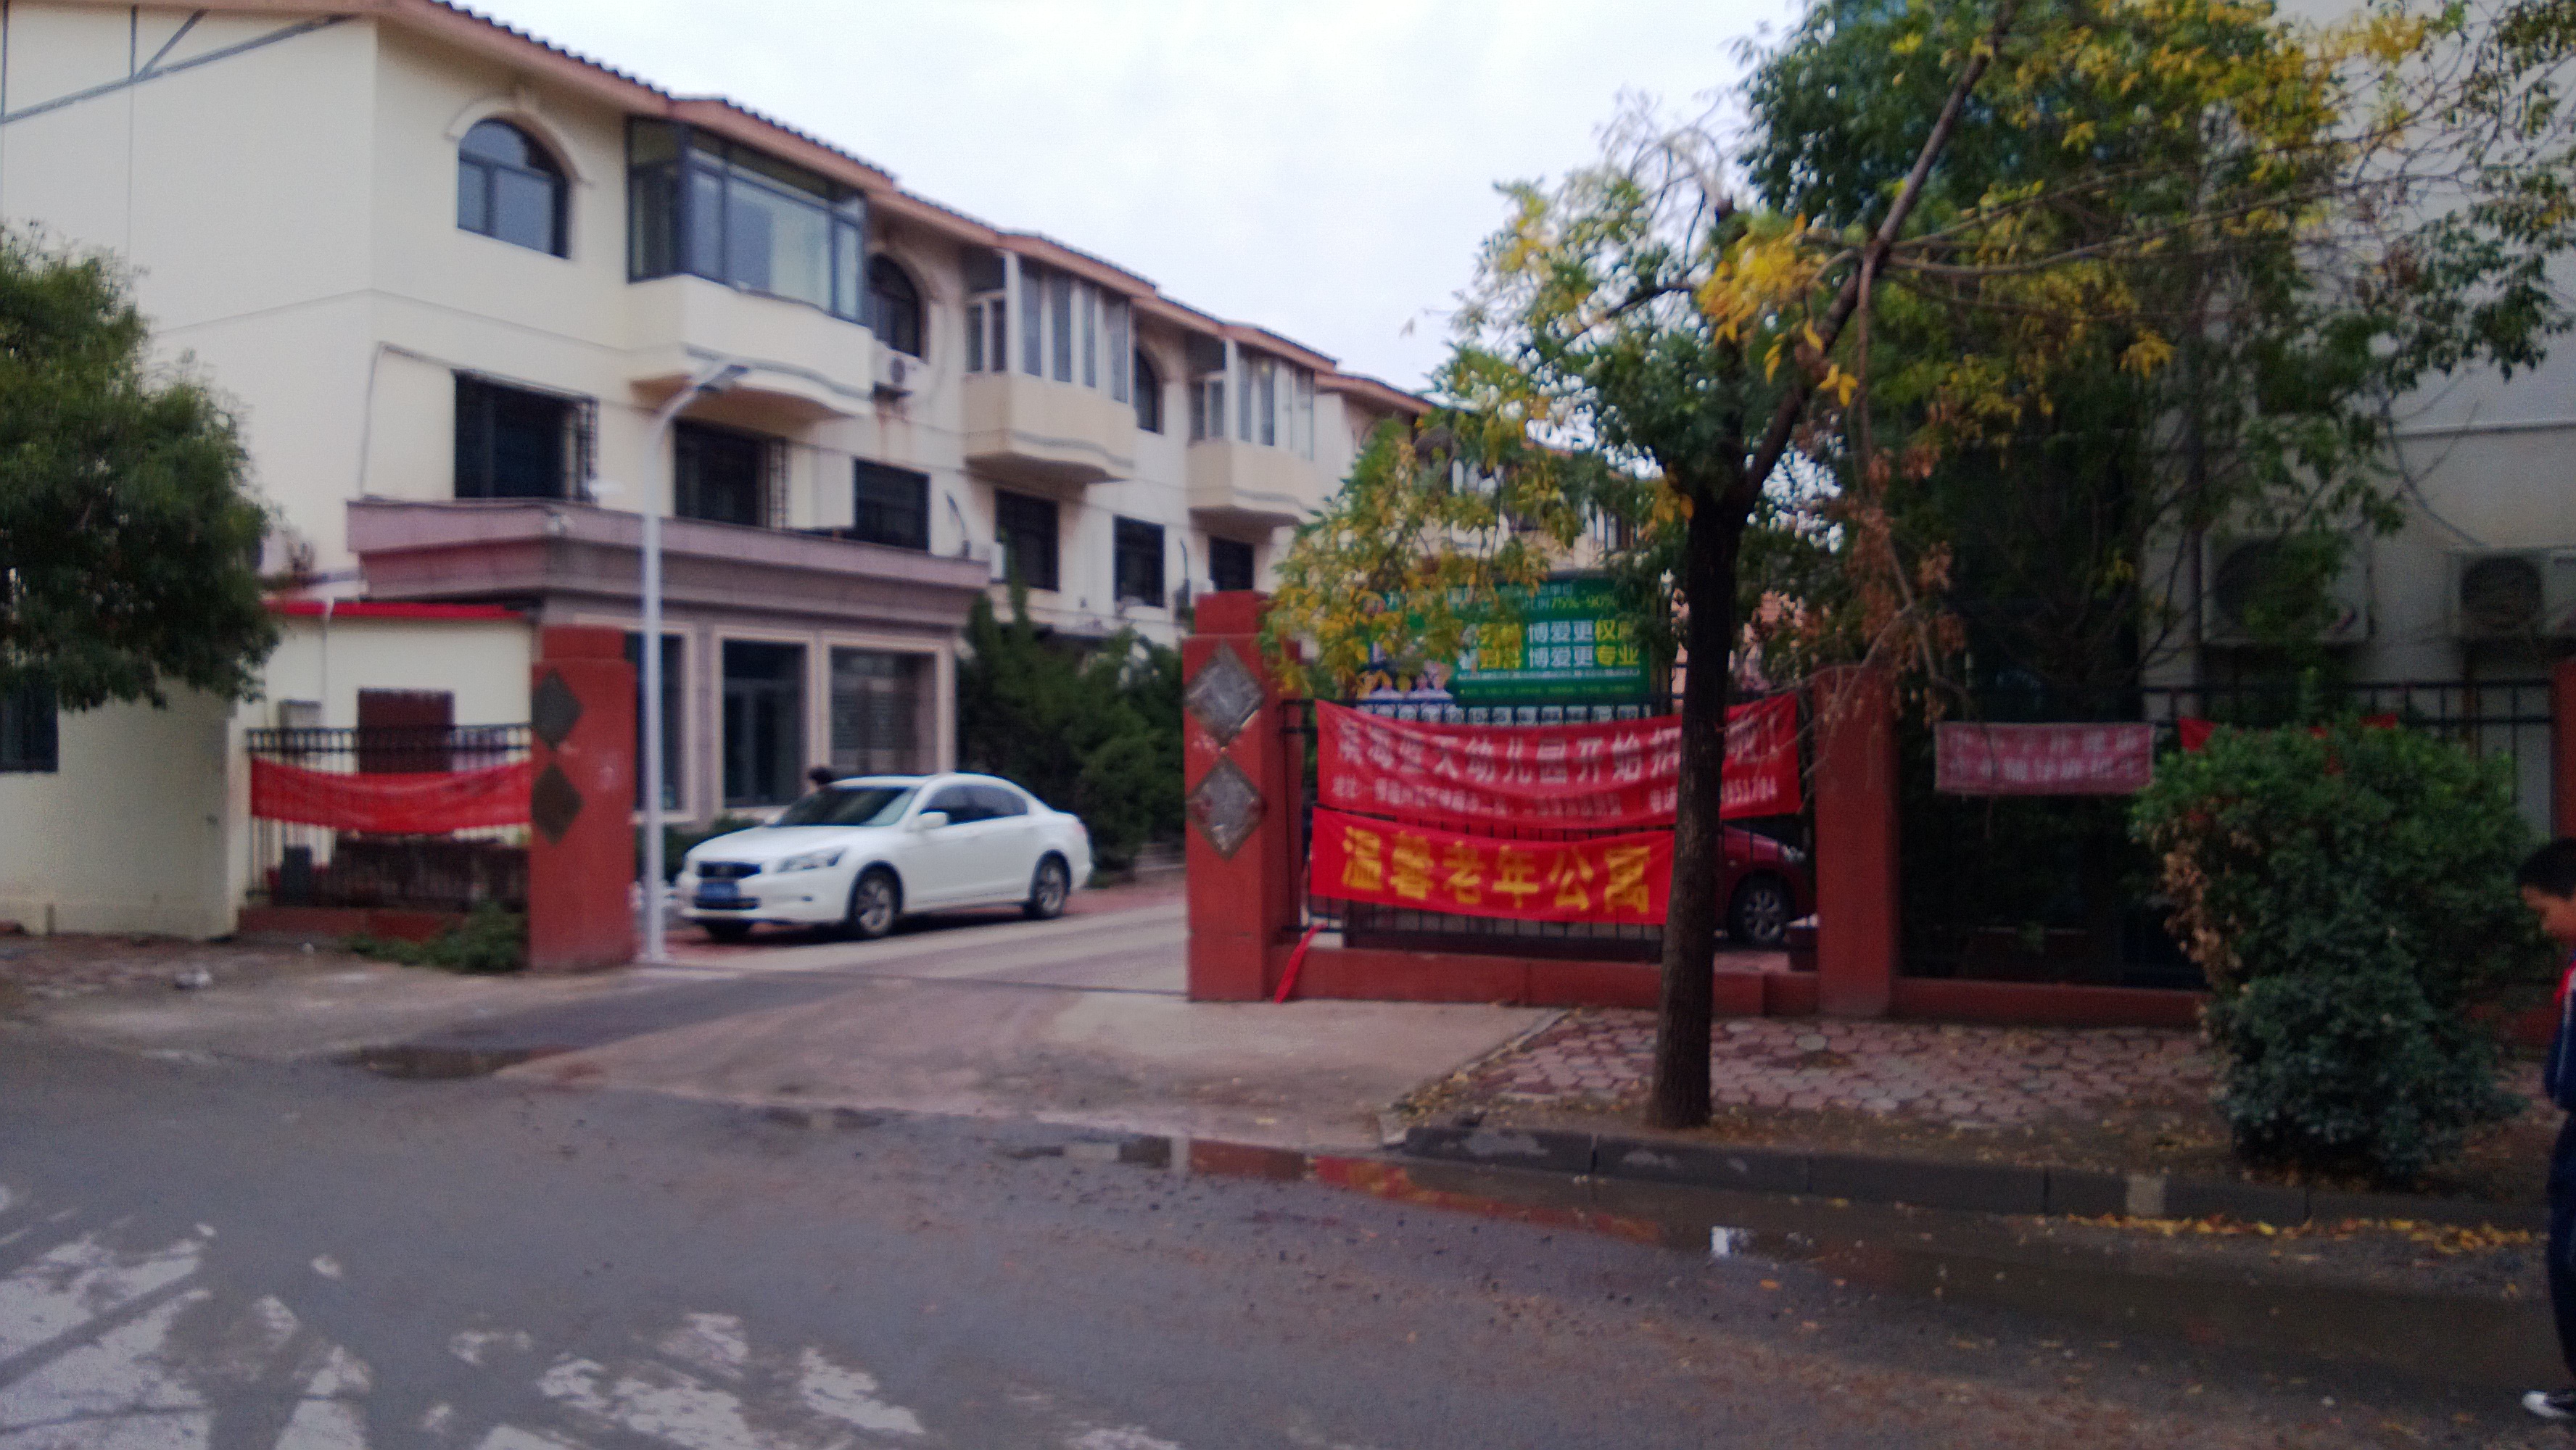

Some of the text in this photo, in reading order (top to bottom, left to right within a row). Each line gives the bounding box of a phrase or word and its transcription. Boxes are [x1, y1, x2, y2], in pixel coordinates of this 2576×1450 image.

[1342, 826, 1651, 914] 温馨老年公寓
